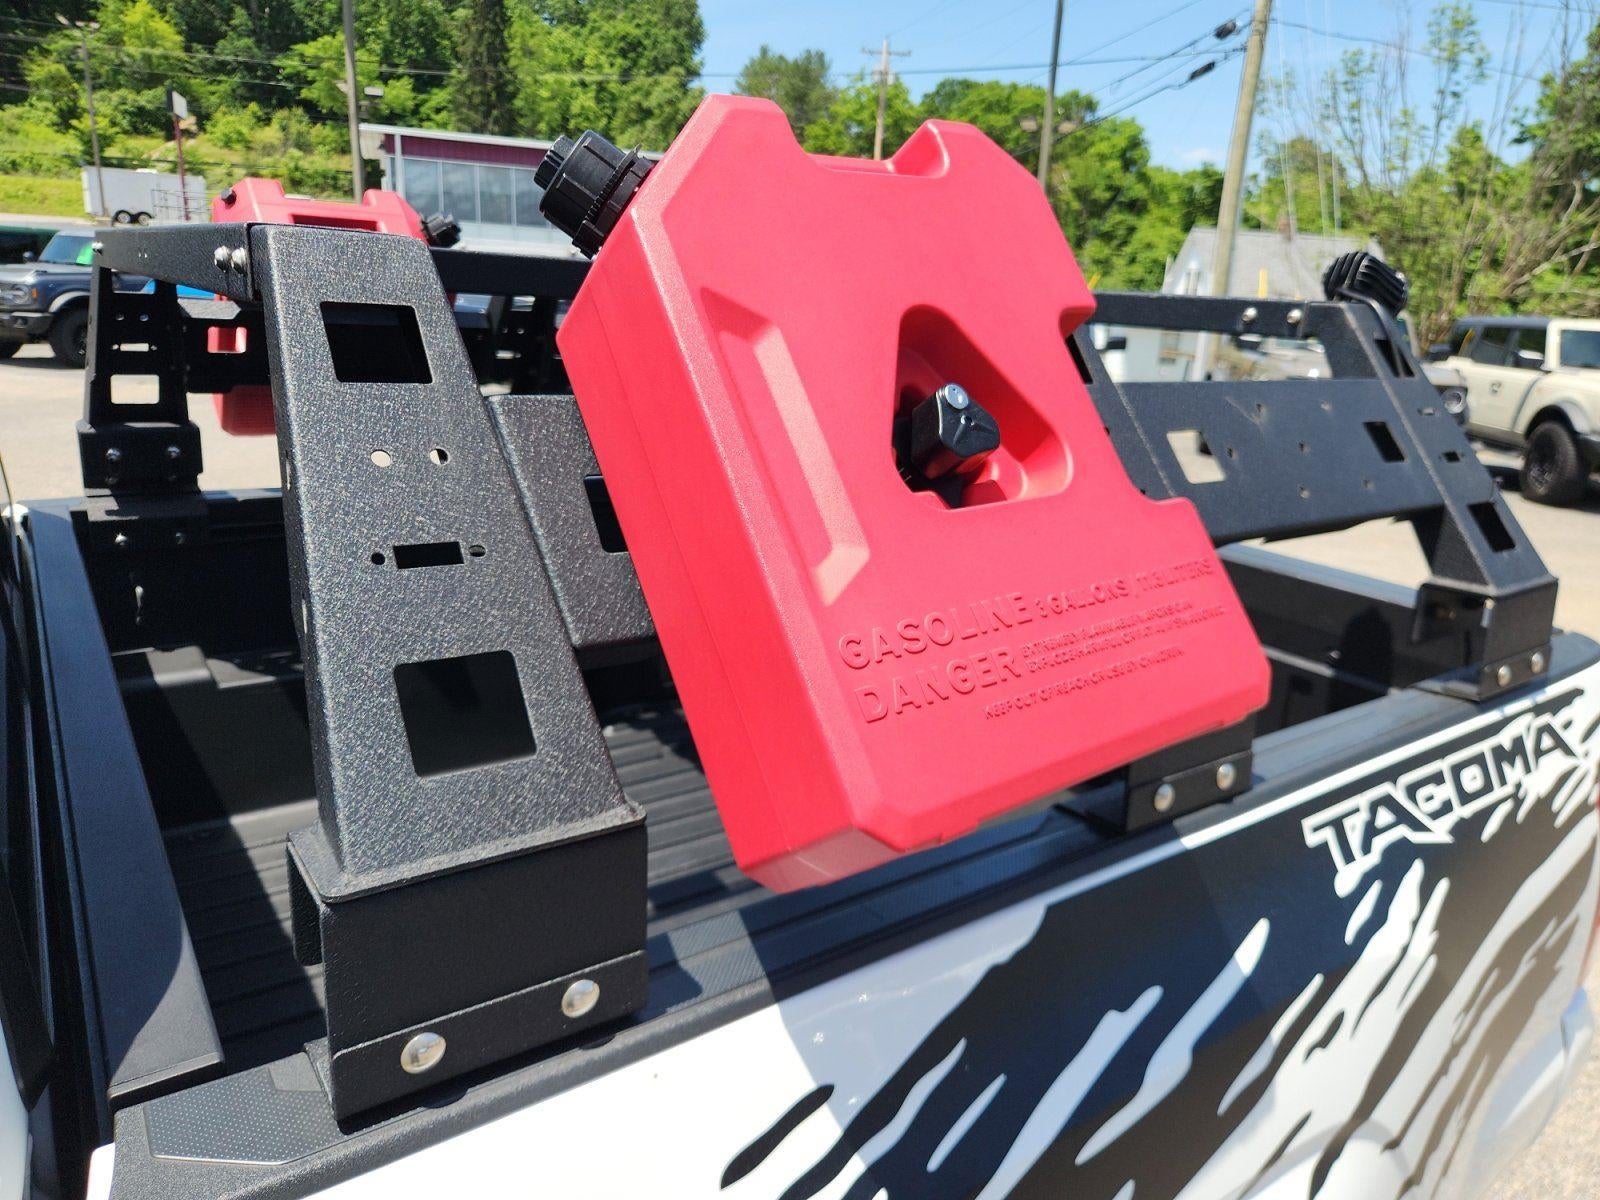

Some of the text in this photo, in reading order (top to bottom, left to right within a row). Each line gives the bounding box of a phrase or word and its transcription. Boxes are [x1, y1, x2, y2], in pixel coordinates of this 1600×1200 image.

[838, 592, 1032, 670] GASOLINE
[1048, 577, 1129, 615] GALLONS
[855, 647, 1022, 724] DANGER
[1301, 711, 1578, 866] TACOMA
